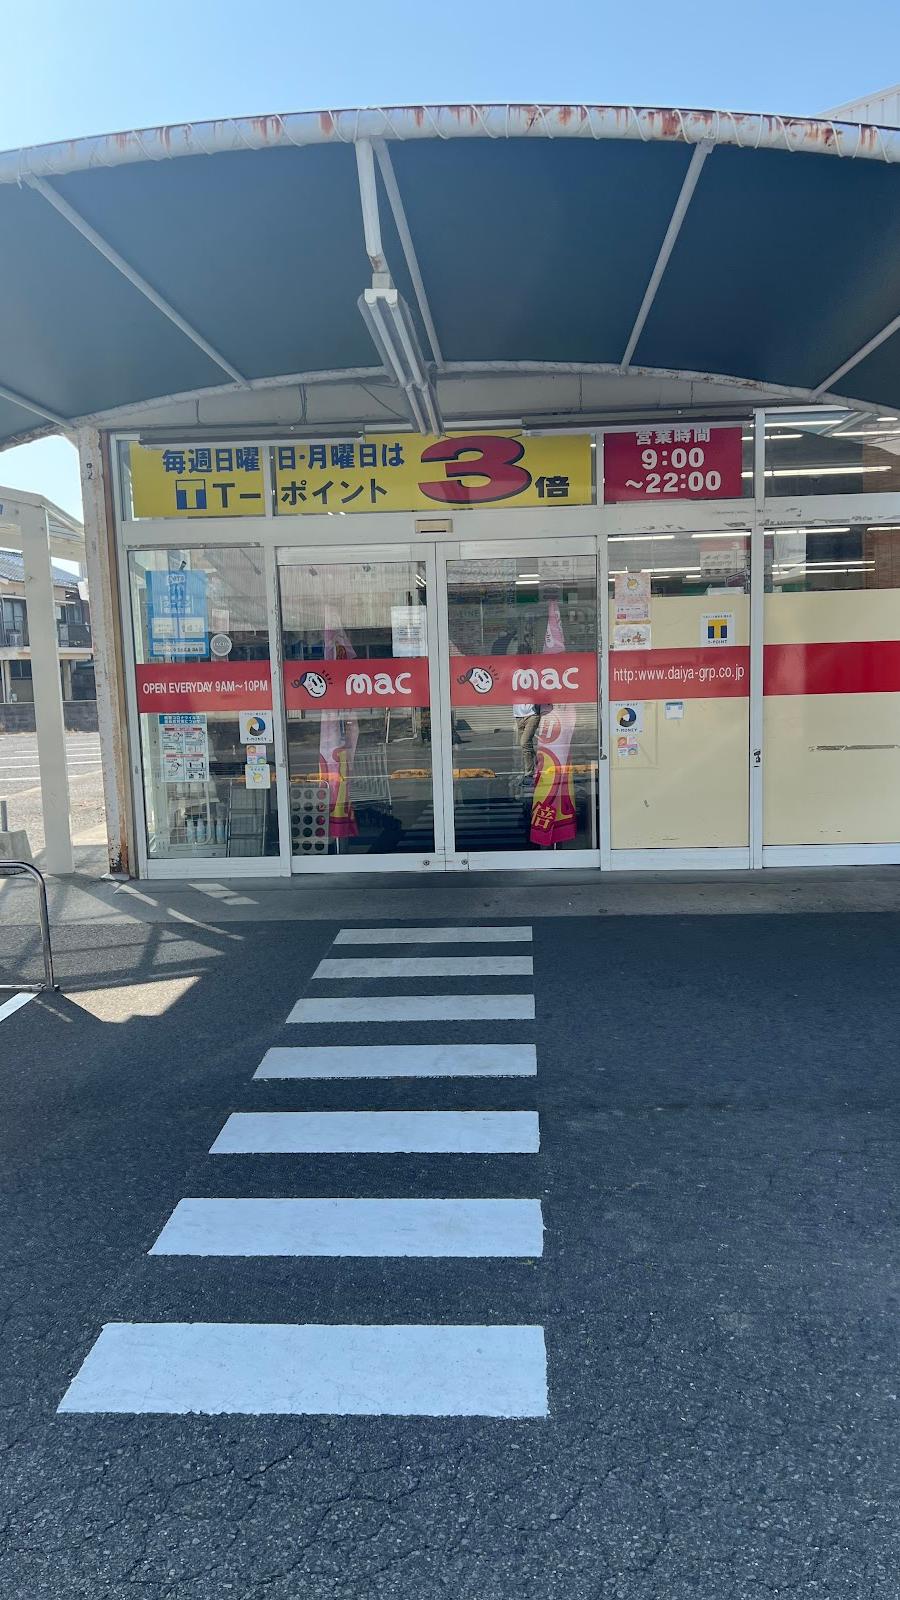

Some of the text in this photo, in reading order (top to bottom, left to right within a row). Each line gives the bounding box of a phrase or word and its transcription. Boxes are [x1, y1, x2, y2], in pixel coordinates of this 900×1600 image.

[641, 447, 705, 470] 9:00
[345, 672, 412, 695] mac
[511, 666, 579, 691] mac
[613, 664, 745, 686] http:www.daiya-grp.co.jp
[143, 682, 167, 695] OPEN
[168, 681, 213, 694] EVERYDAY
